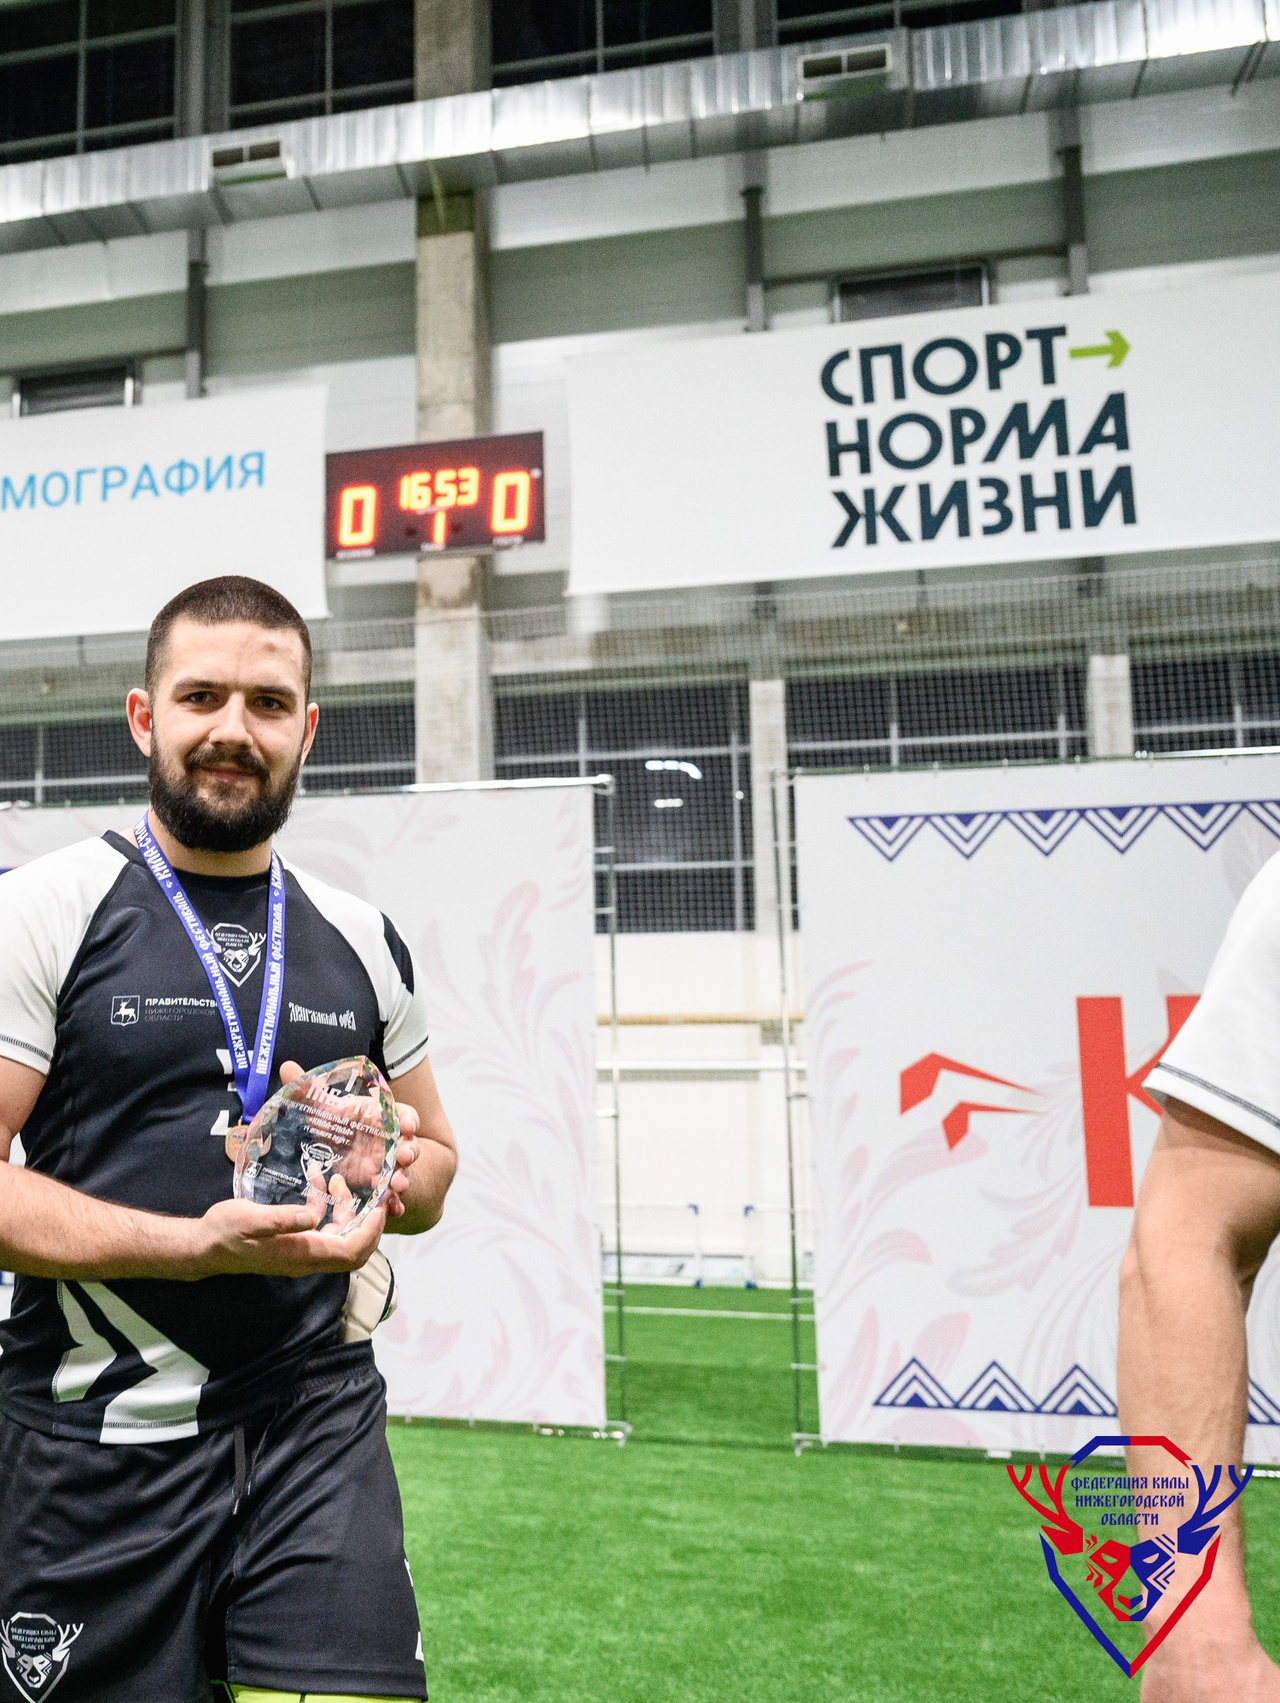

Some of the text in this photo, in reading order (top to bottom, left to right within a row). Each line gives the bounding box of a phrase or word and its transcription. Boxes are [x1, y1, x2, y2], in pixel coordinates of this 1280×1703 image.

[820, 325, 1067, 406] СПОРТ
[825, 391, 1131, 478] НОРМА
[338, 485, 377, 548] 0
[491, 470, 531, 534] 0
[831, 464, 1137, 550] ЖИЗНИ
[145, 997, 218, 1008] ПРАВИТЕЛЬСТВ
